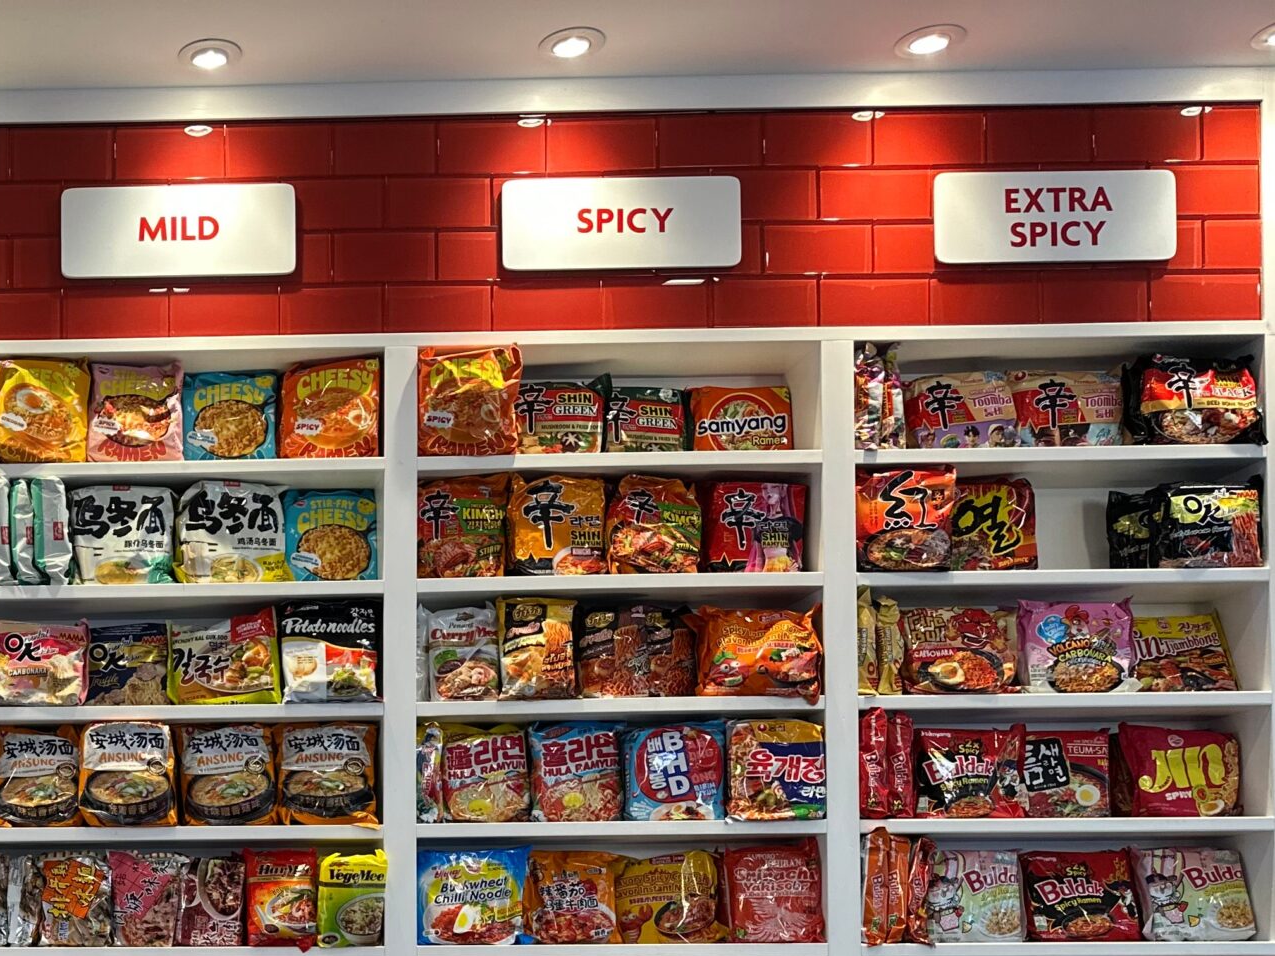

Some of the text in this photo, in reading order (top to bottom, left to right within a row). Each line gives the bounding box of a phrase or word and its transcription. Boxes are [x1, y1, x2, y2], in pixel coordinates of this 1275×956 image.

[1004, 186, 1112, 213] EXTRA
[577, 207, 674, 233] SPICY
[138, 216, 219, 242] MILD
[1010, 220, 1107, 248] SPICY
[296, 369, 374, 399] CHEESY
[556, 393, 593, 405] SHIN
[925, 380, 963, 430] 辛
[1034, 379, 1077, 429] 辛
[552, 404, 599, 417] GREEN
[639, 405, 672, 418] SHIN
[426, 415, 452, 426] SPICY
[637, 417, 678, 429] GREEN
[295, 422, 320, 433] SPICY
[523, 479, 576, 550] 辛
[721, 489, 766, 549] 辛
[296, 511, 368, 532] CHEESY
[571, 530, 601, 540] SHIN
[761, 532, 789, 542] SHIN
[9, 756, 57, 768] ANSUNG
[197, 752, 245, 766] ANSUNG
[295, 752, 344, 764] ANSUNG
[447, 768, 477, 781] HULA
[543, 766, 574, 778] HULA
[1036, 877, 1105, 905] Buldak
